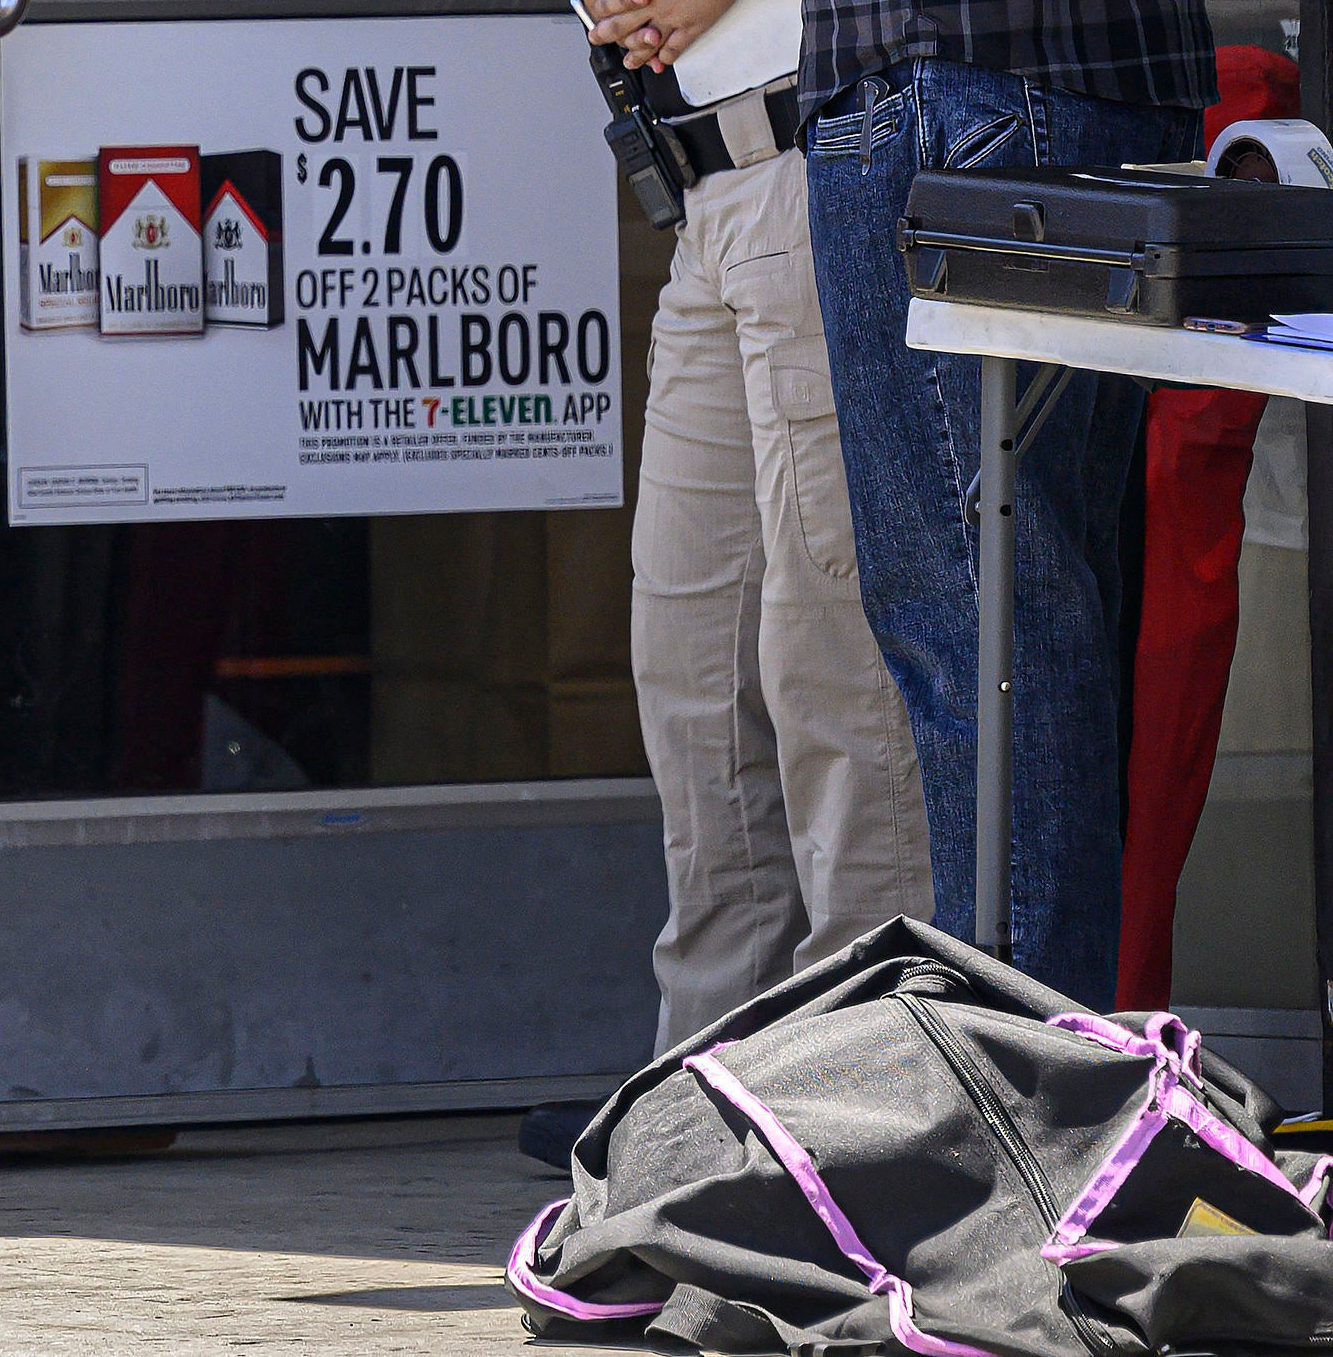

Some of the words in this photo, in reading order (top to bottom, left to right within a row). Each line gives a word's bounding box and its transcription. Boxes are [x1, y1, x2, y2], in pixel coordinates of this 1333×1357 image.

[295, 67, 438, 142] SAVE
[297, 153, 464, 255] $2.70
[106, 259, 200, 314] Marlboro
[205, 258, 266, 310] arlboro
[297, 268, 354, 310] OFF
[362, 268, 379, 307] 2
[387, 266, 491, 306] PACKS
[498, 264, 538, 304] OF
[297, 310, 610, 391] MARLBORO
[299, 399, 363, 431] WITH
[369, 398, 415, 428] THE
[562, 393, 611, 425] APP
[300, 436, 319, 448] THIS
[321, 435, 369, 447] PROMOTION
[373, 435, 381, 447] IS
[391, 434, 429, 446] RETAILER
[463, 433, 496, 444] FUNDED
[497, 432, 508, 443] BY
[510, 432, 525, 443] THE
[300, 451, 350, 465] EXCLUSIONS
[495, 446, 530, 459] MARKED
